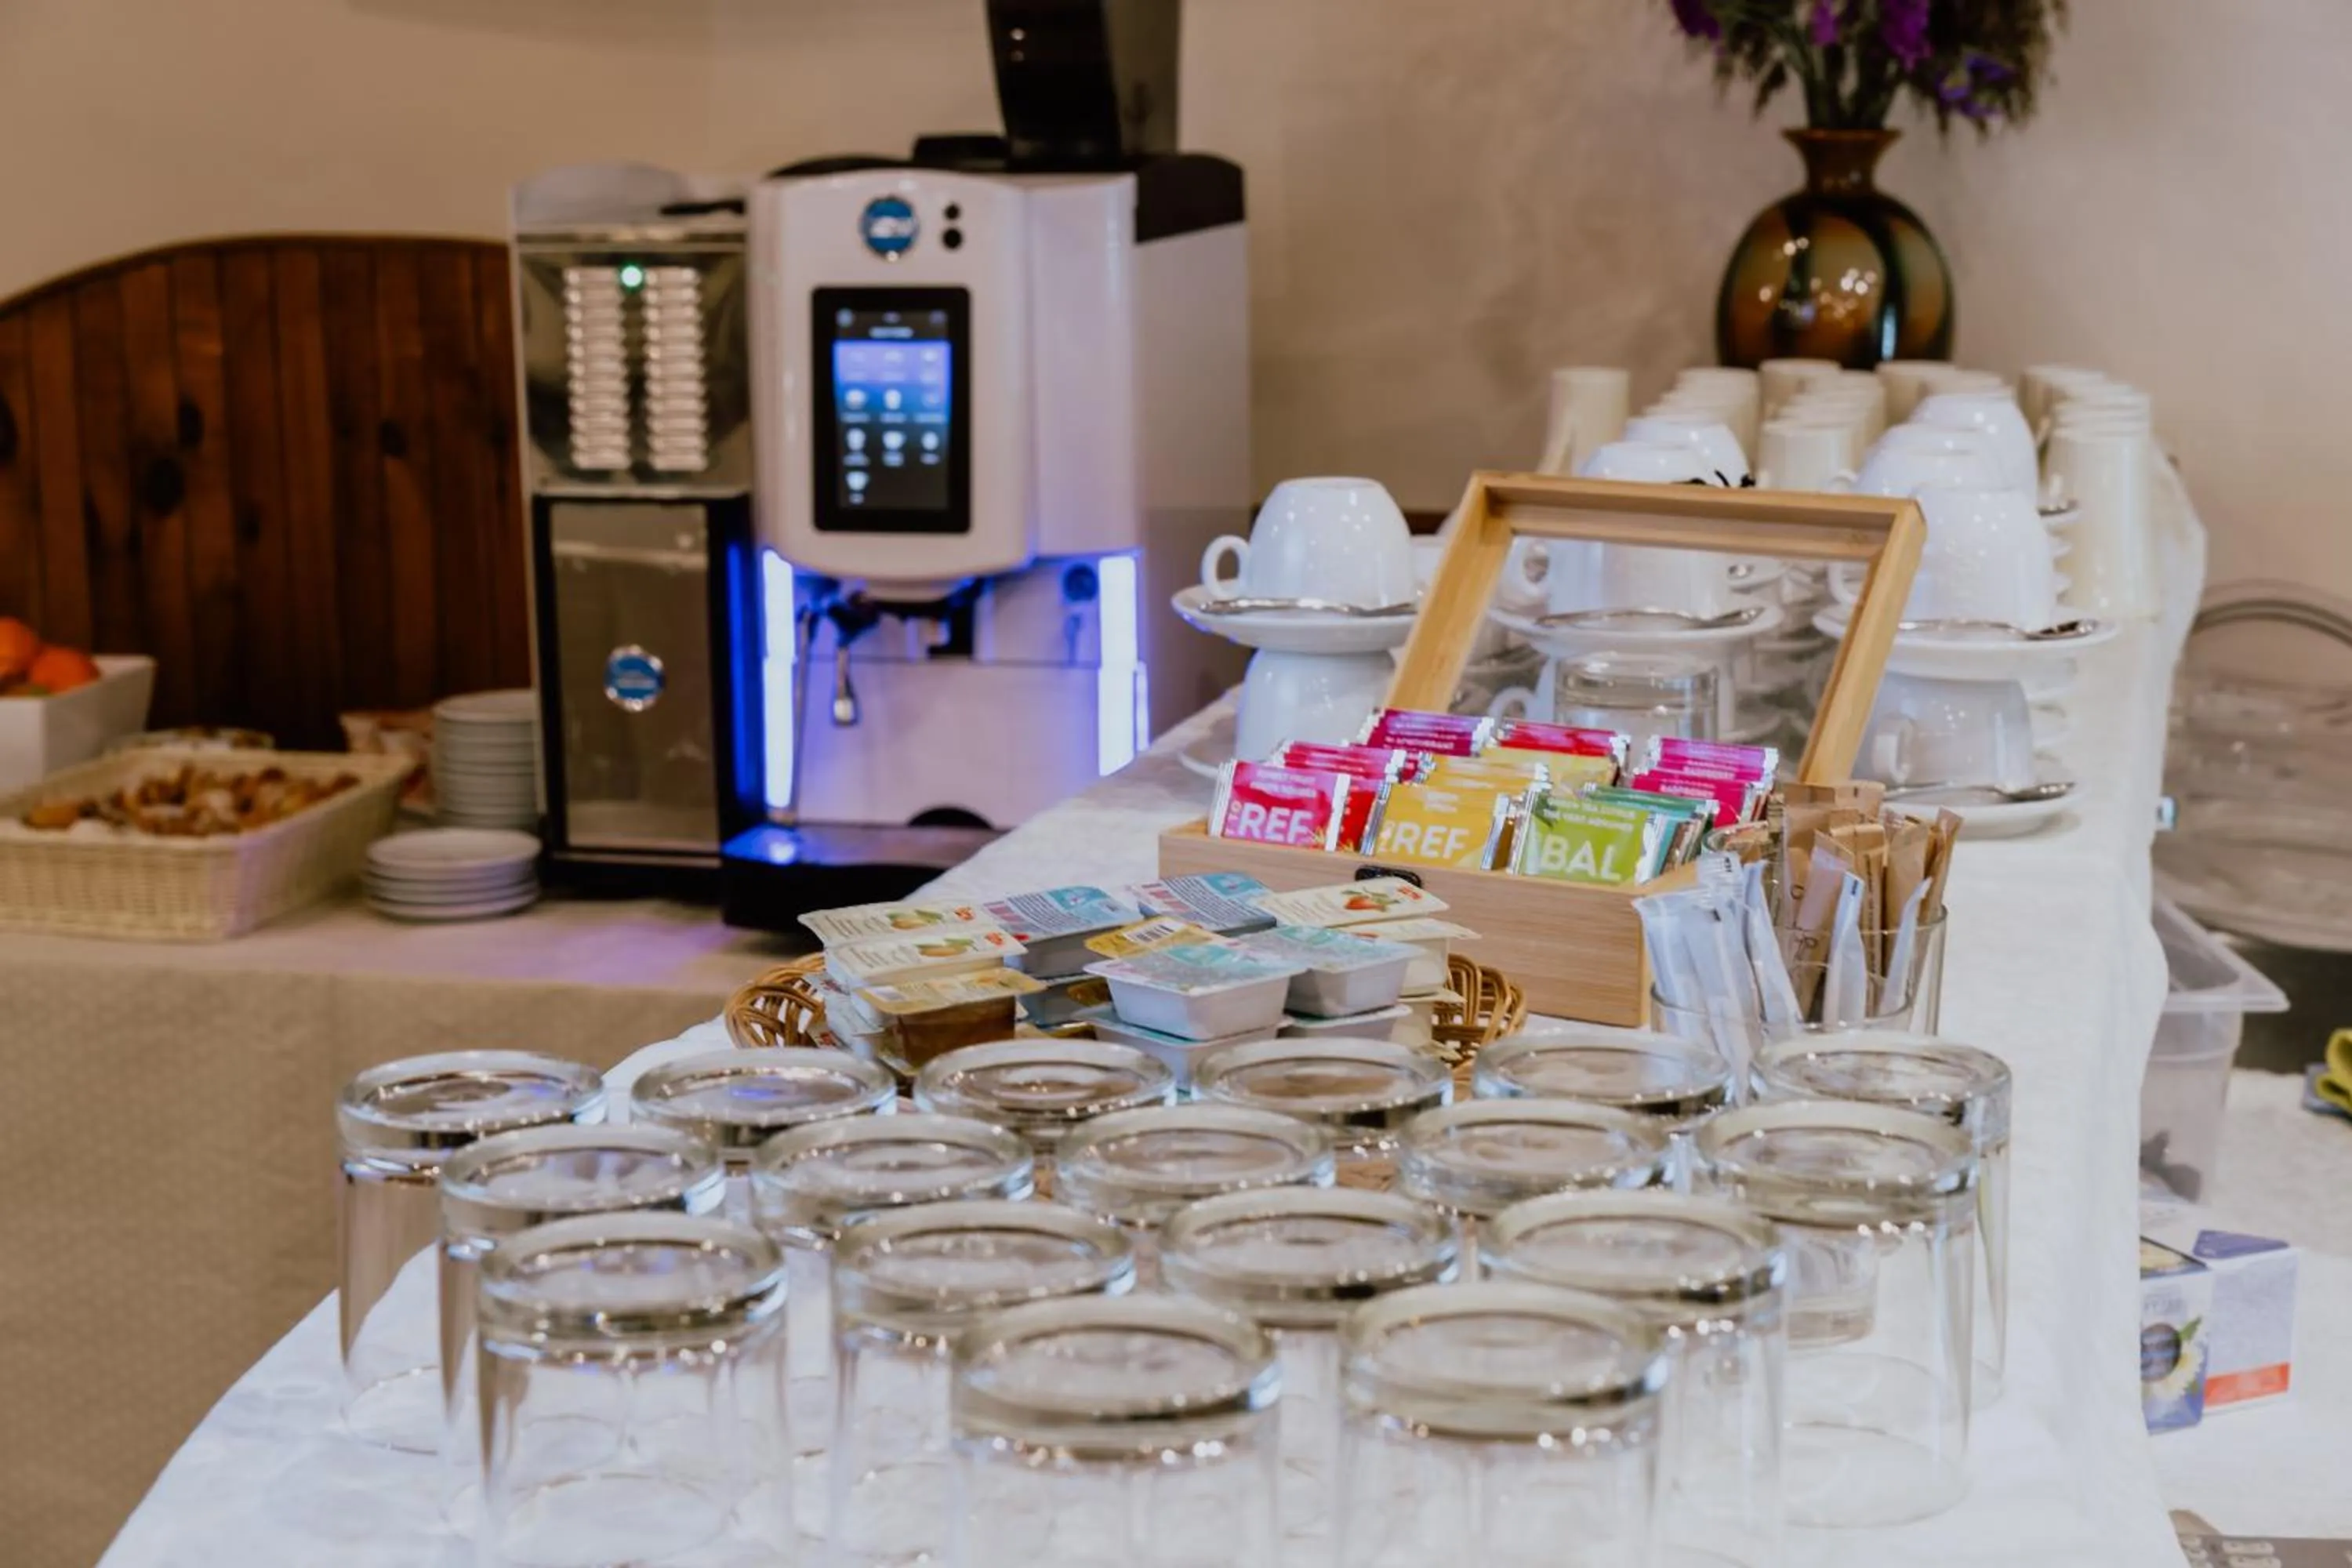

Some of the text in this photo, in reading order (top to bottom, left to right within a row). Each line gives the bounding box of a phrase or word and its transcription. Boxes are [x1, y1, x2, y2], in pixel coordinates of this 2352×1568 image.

[1236, 802, 1314, 844] REF
[1391, 821, 1470, 860] REF
[1540, 833, 1622, 881] BAL
